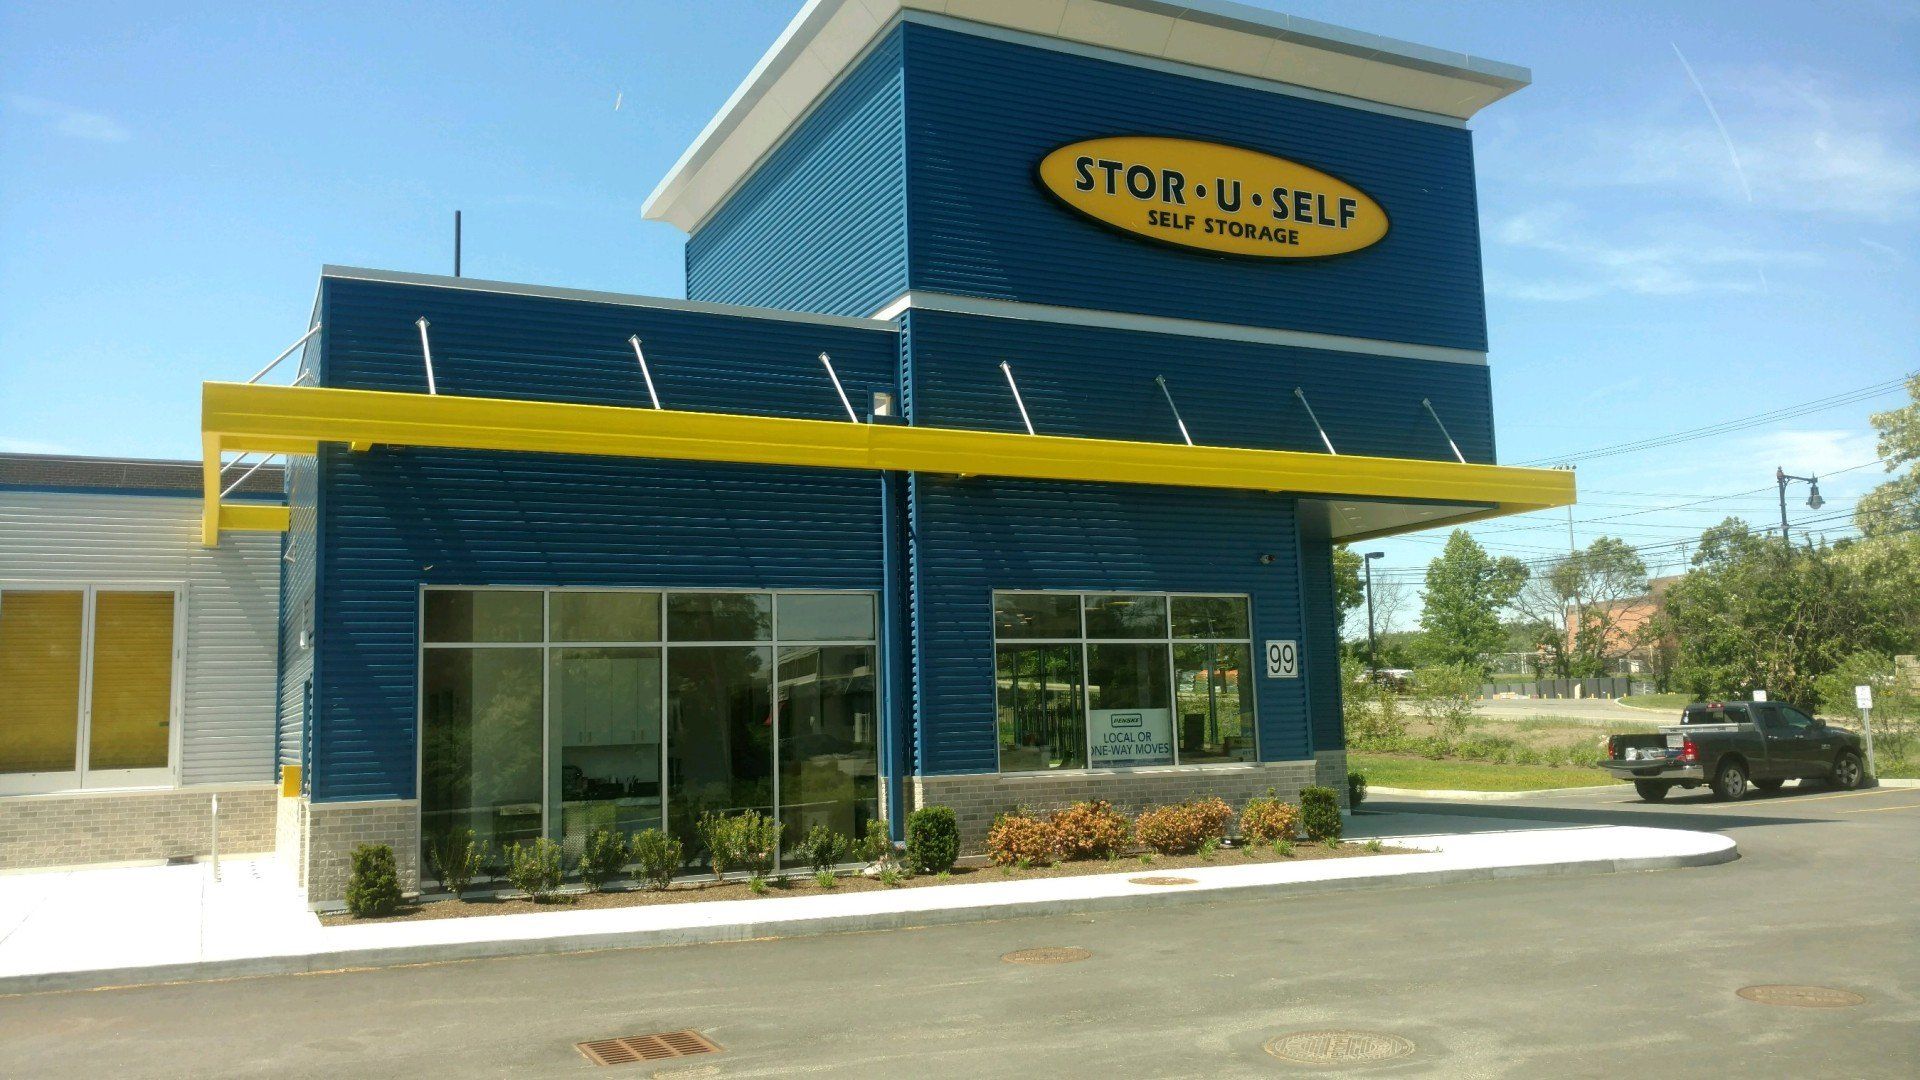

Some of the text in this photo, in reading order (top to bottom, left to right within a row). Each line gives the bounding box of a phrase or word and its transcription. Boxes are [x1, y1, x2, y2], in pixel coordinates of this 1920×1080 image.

[1148, 209, 1300, 246] SELF STORAGE
[1269, 644, 1294, 674] 99
[1103, 731, 1152, 743] LOCAL OR
[1135, 743, 1169, 755] MOVES
